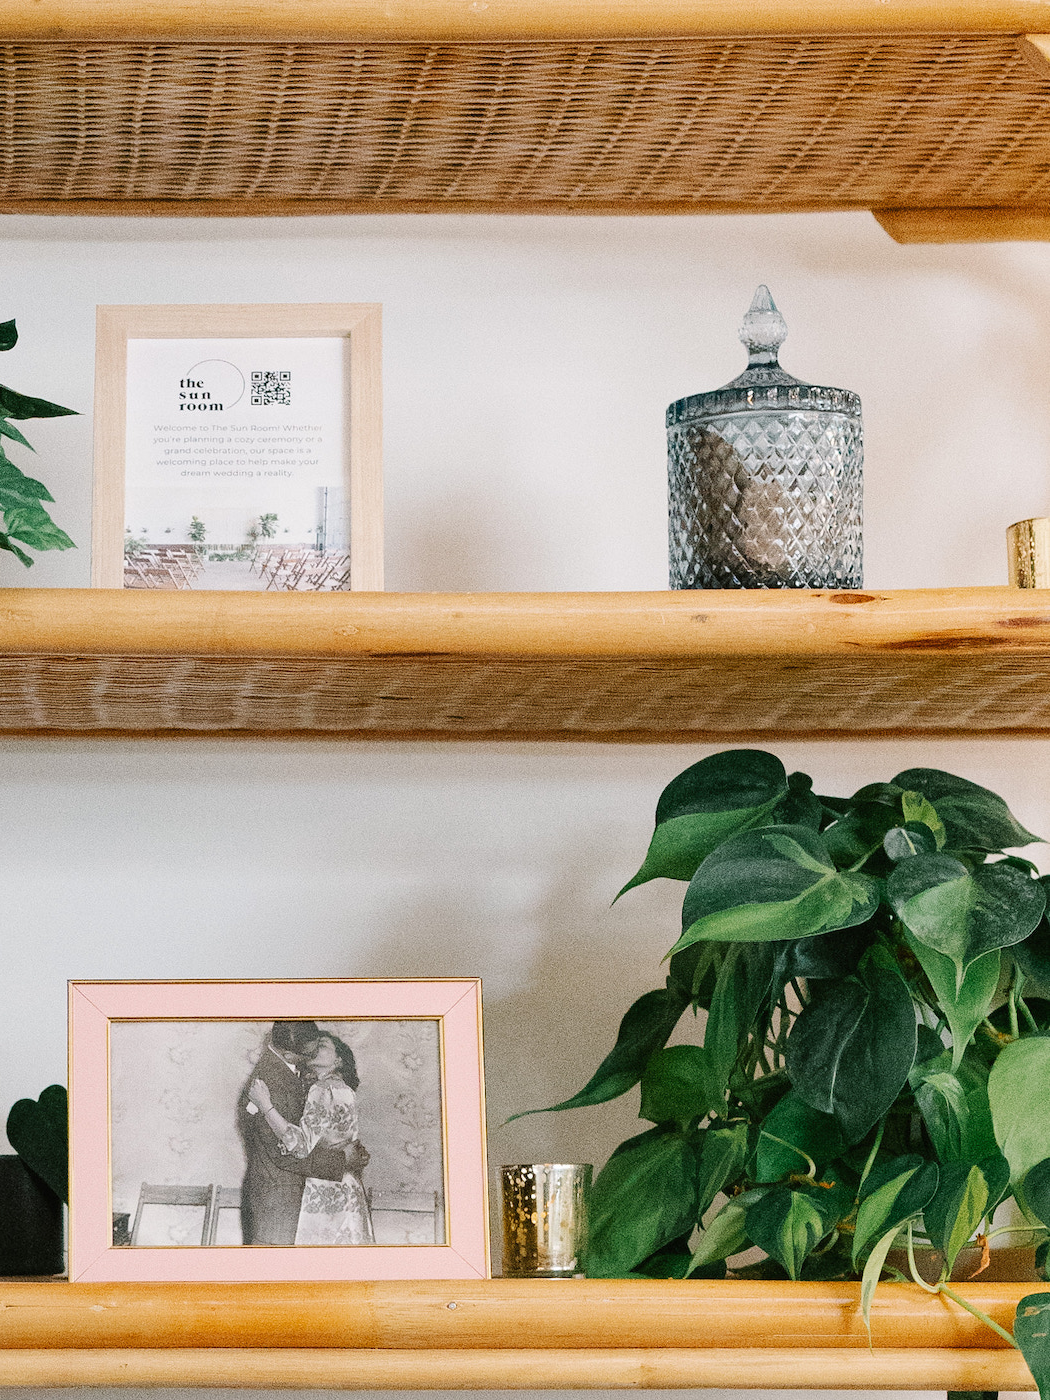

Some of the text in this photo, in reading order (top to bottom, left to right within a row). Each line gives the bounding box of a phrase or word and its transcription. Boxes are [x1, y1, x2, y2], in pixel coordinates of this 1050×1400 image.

[179, 378, 204, 389] the
[178, 391, 211, 400] sun
[178, 402, 224, 411] room
[153, 436, 181, 444] you're
[183, 436, 224, 444] planning
[164, 447, 191, 455] grand
[194, 447, 248, 455] celebration,
[156, 458, 206, 466] welcoming
